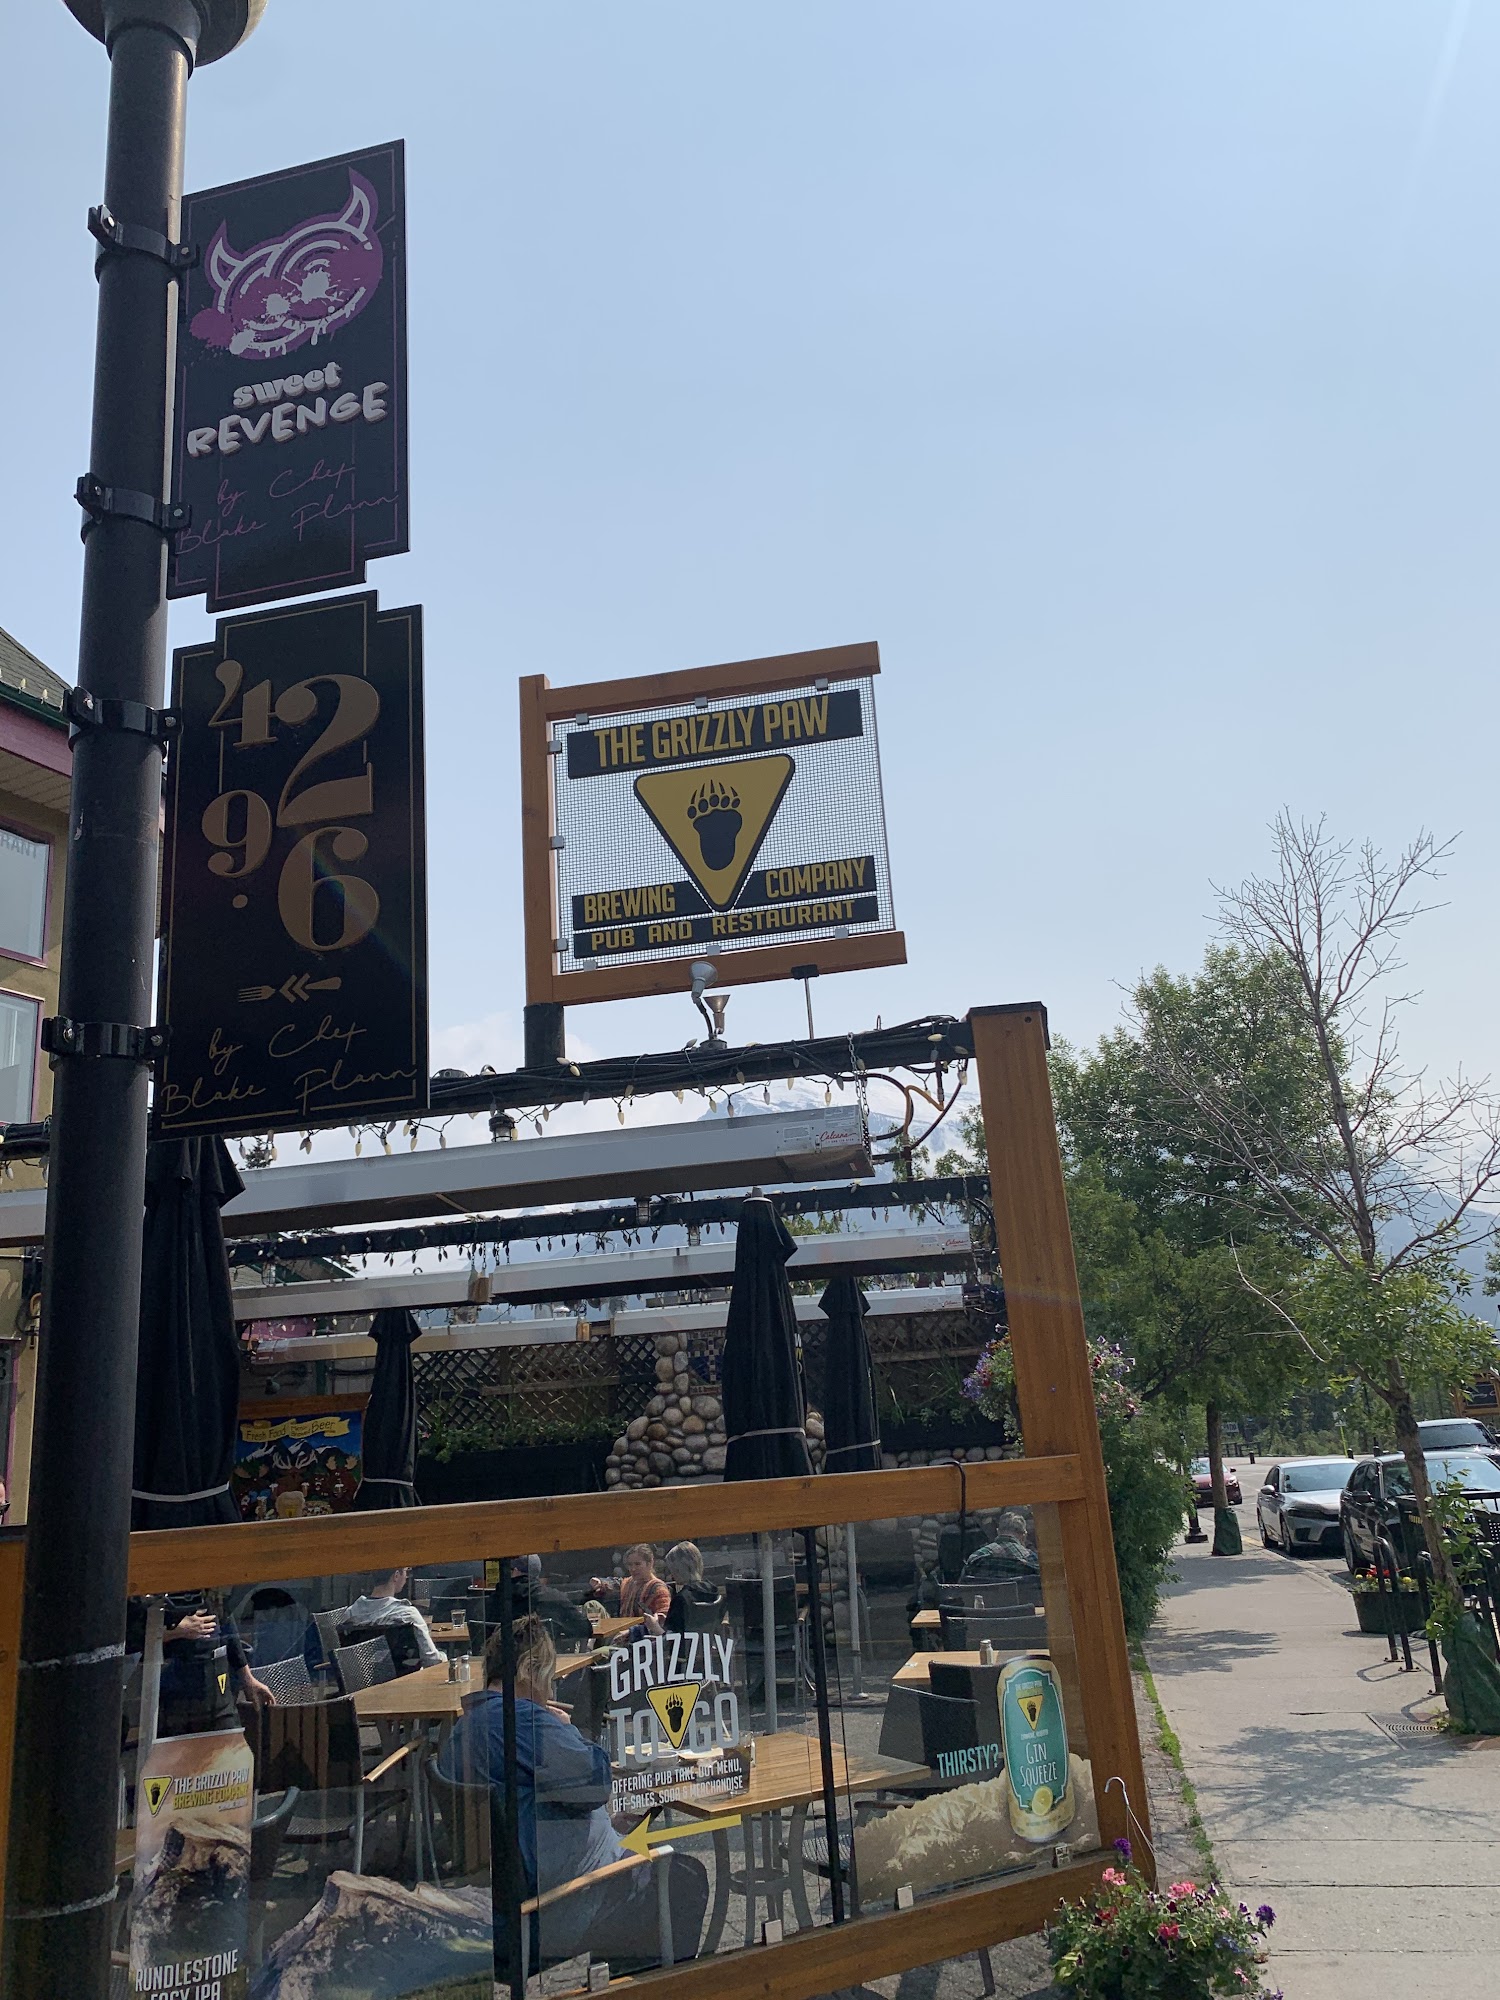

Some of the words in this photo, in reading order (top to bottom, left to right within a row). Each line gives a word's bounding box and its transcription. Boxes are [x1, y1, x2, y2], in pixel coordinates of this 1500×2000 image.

[233, 361, 342, 409] sweet
[186, 382, 388, 458] REVENGE
[217, 479, 247, 517] by
[175, 516, 267, 554] Blake
[594, 722, 646, 768] THE
[652, 707, 755, 760] GRIZZLY
[763, 695, 830, 743] PAW
[583, 884, 676, 923] BREWING
[764, 858, 867, 899] COMPANY
[591, 926, 635, 951] PUB
[647, 920, 693, 944] AND
[711, 899, 856, 936] RESTAURANT
[209, 1027, 245, 1073] by
[161, 1080, 266, 1117] Blake
[311, 1420, 336, 1433] Beer
[610, 1631, 734, 1702] GRIZZLY
[609, 1707, 660, 1769] TO
[689, 1691, 740, 1754] GO
[937, 1744, 999, 1779] THIRSTY?
[1026, 1742, 1047, 1765] GIN
[174, 1777, 194, 1795] THE
[195, 1772, 230, 1792] GRIZZLY
[231, 1768, 250, 1785] PAW
[612, 1772, 653, 1794] OFFERING
[655, 1770, 673, 1786] PUB
[716, 1758, 742, 1774] MENU,
[659, 1786, 680, 1804] SODA
[682, 1785, 689, 1800] &
[690, 1775, 743, 1799] MERCHANDISE
[1019, 1761, 1058, 1792] SQUEEZE
[173, 1790, 213, 1810] BREWING
[213, 1783, 249, 1804] COMPANY
[135, 1949, 239, 1992] RUNDLESTONE
[195, 1981, 221, 2000] IPA
